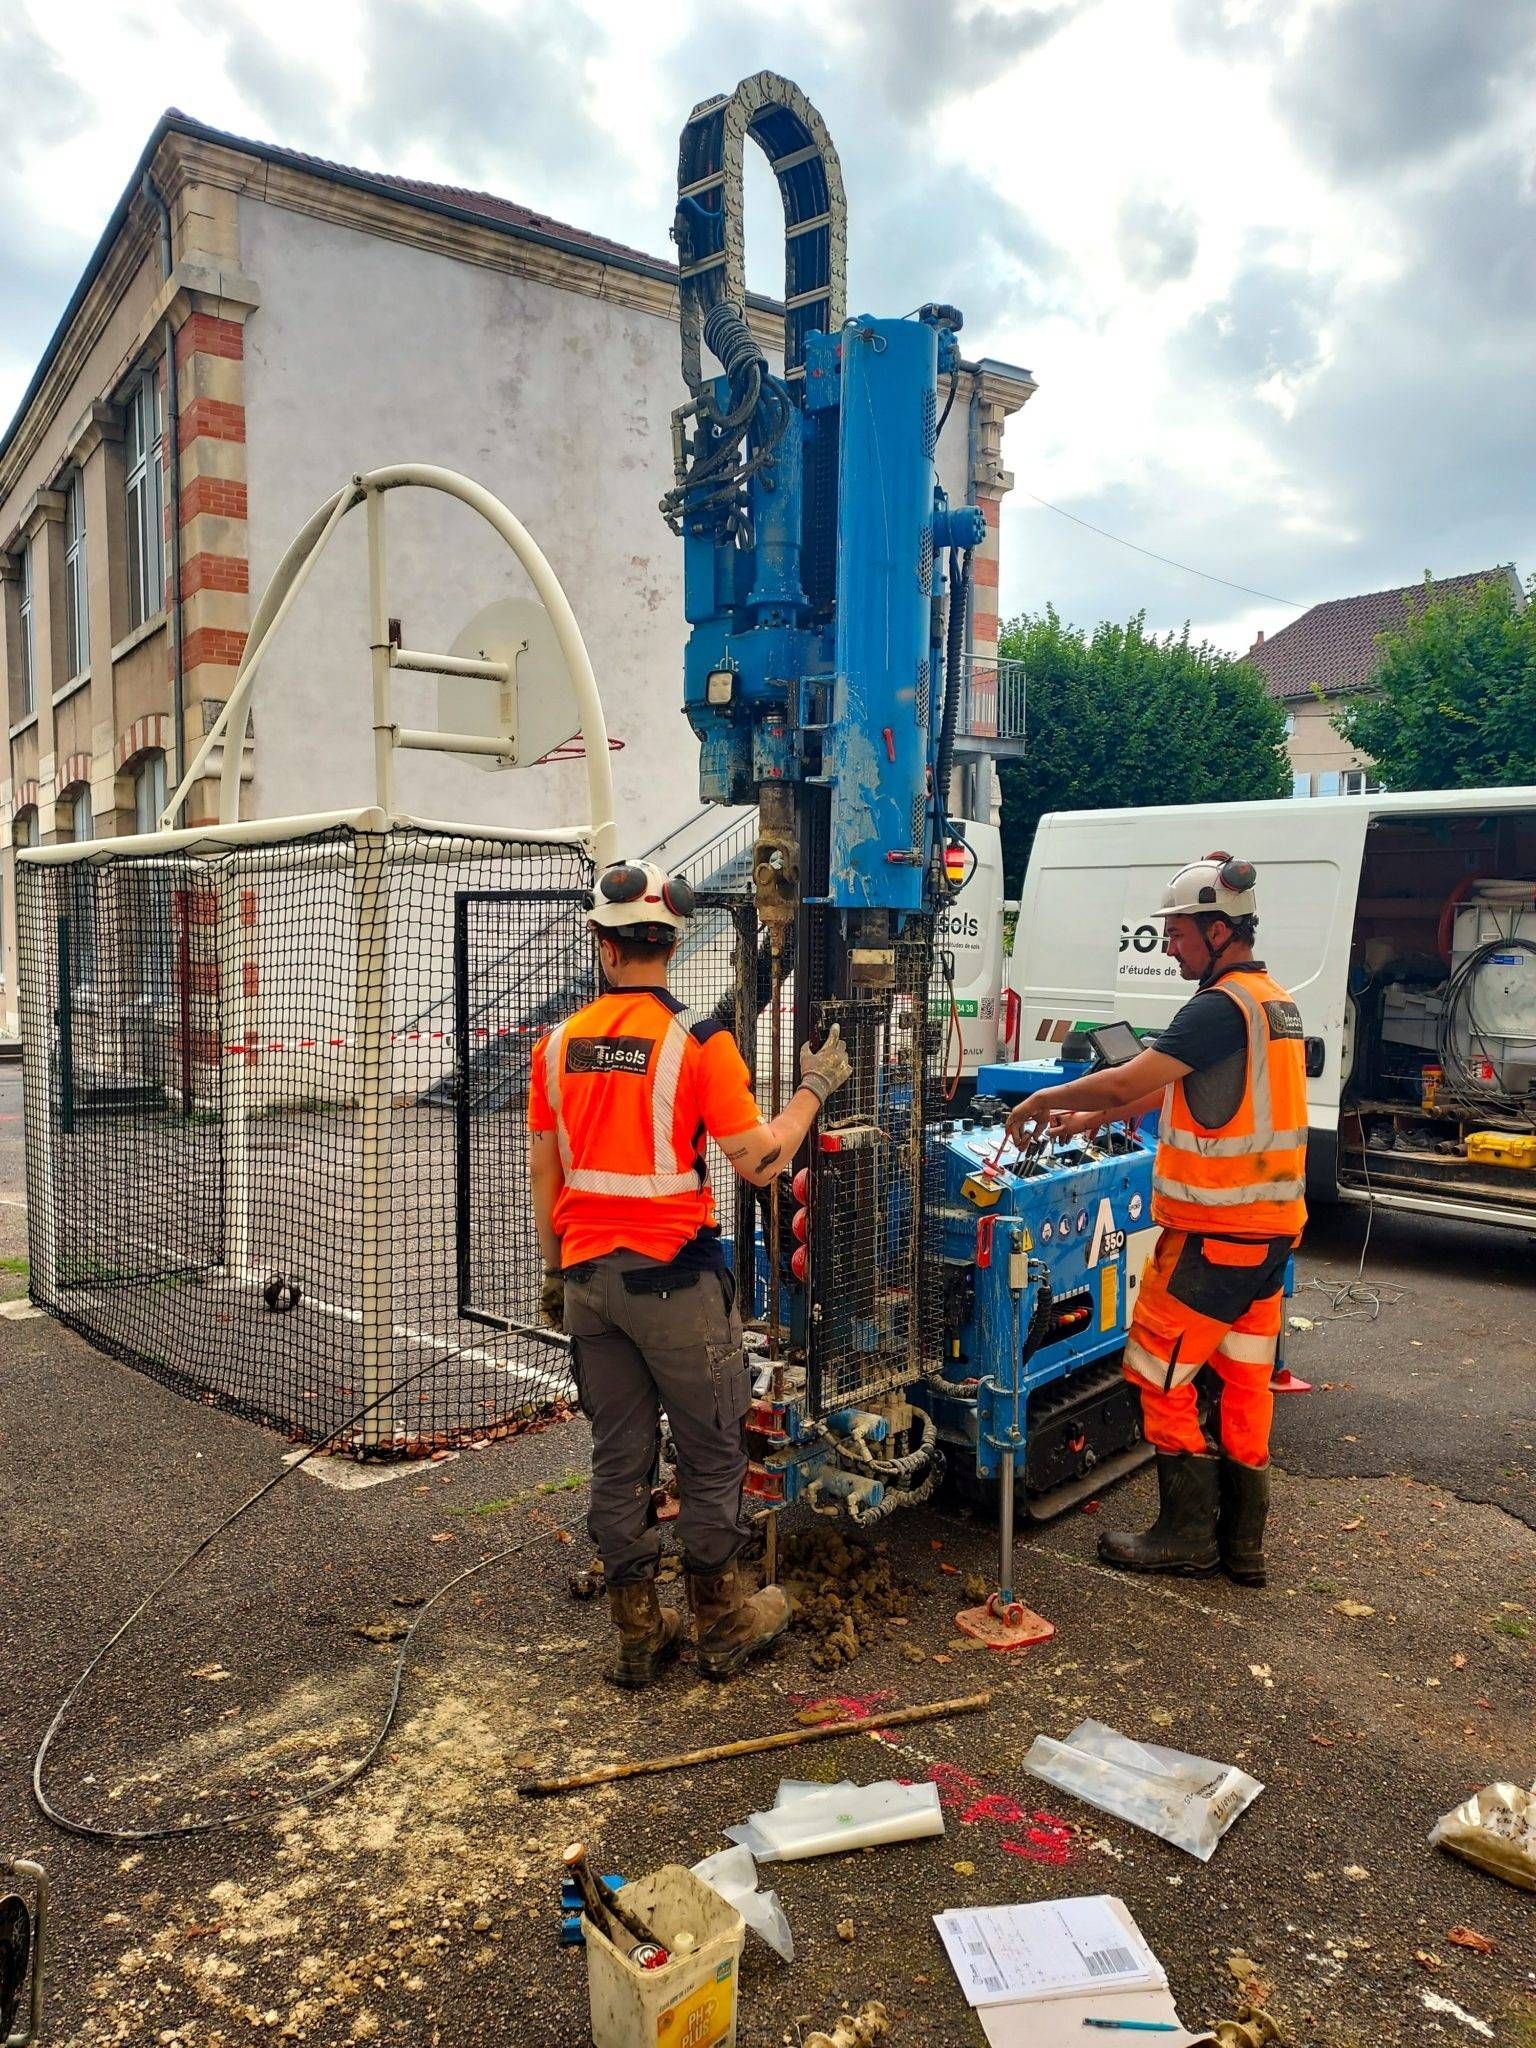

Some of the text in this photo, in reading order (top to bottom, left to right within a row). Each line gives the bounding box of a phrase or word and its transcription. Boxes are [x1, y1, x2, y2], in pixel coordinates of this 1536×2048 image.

[1119, 965, 1177, 976] d'études de
[966, 1004, 974, 1013] 38
[1104, 1230, 1125, 1252] 350
[682, 2018, 710, 2048] PLUS
